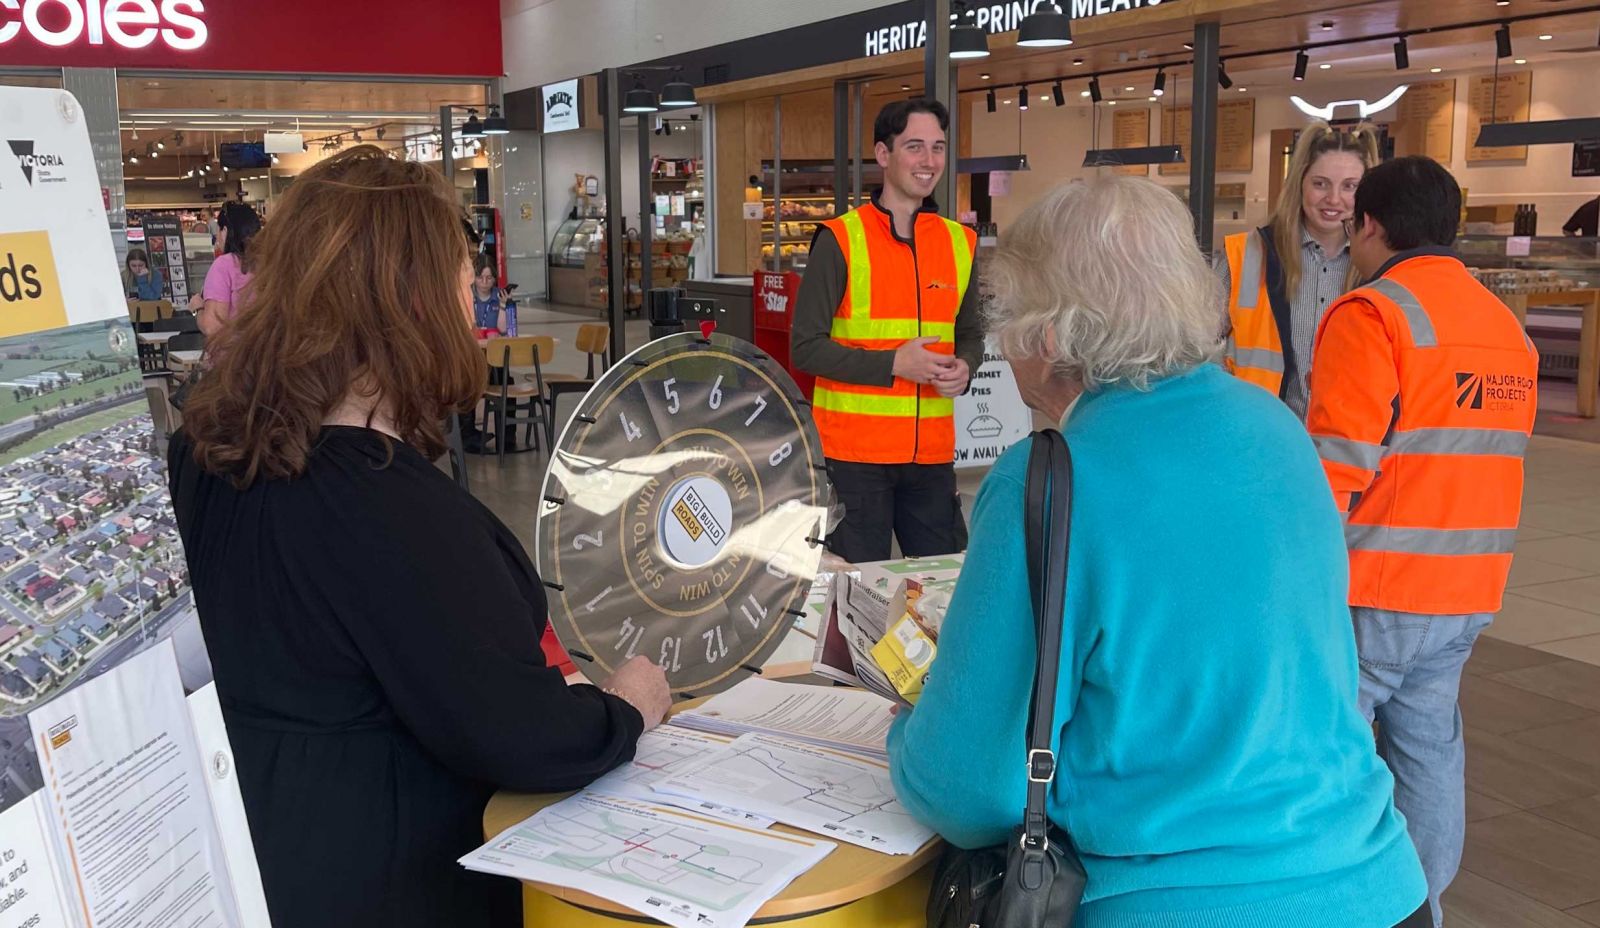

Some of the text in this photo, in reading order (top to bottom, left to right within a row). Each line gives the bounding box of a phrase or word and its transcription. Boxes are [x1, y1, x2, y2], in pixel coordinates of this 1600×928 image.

[16, 154, 64, 167] VICTORIA
[764, 275, 784, 289] FREE
[767, 291, 788, 312] Star
[709, 375, 723, 409] 6
[971, 387, 991, 397] PIES
[1486, 374, 1515, 387] MAJOR
[664, 377, 679, 414] 5
[1486, 387, 1526, 401] PROJECTS
[744, 395, 767, 427] 7
[620, 412, 642, 441] 4
[769, 442, 792, 466] 8
[973, 446, 1006, 459] AVAIL
[727, 458, 752, 502] WIN
[677, 504, 700, 536] ROADS
[686, 493, 721, 540] BIG BUILD
[572, 530, 602, 550] 2
[634, 478, 664, 590] SPIN TO WIN
[586, 586, 613, 612] 1
[679, 581, 711, 601] WIN
[740, 594, 768, 629] 11
[614, 616, 645, 659] 14
[703, 625, 728, 663] 12
[659, 636, 682, 673] 13
[3, 849, 14, 862] to
[9, 859, 28, 882] and
